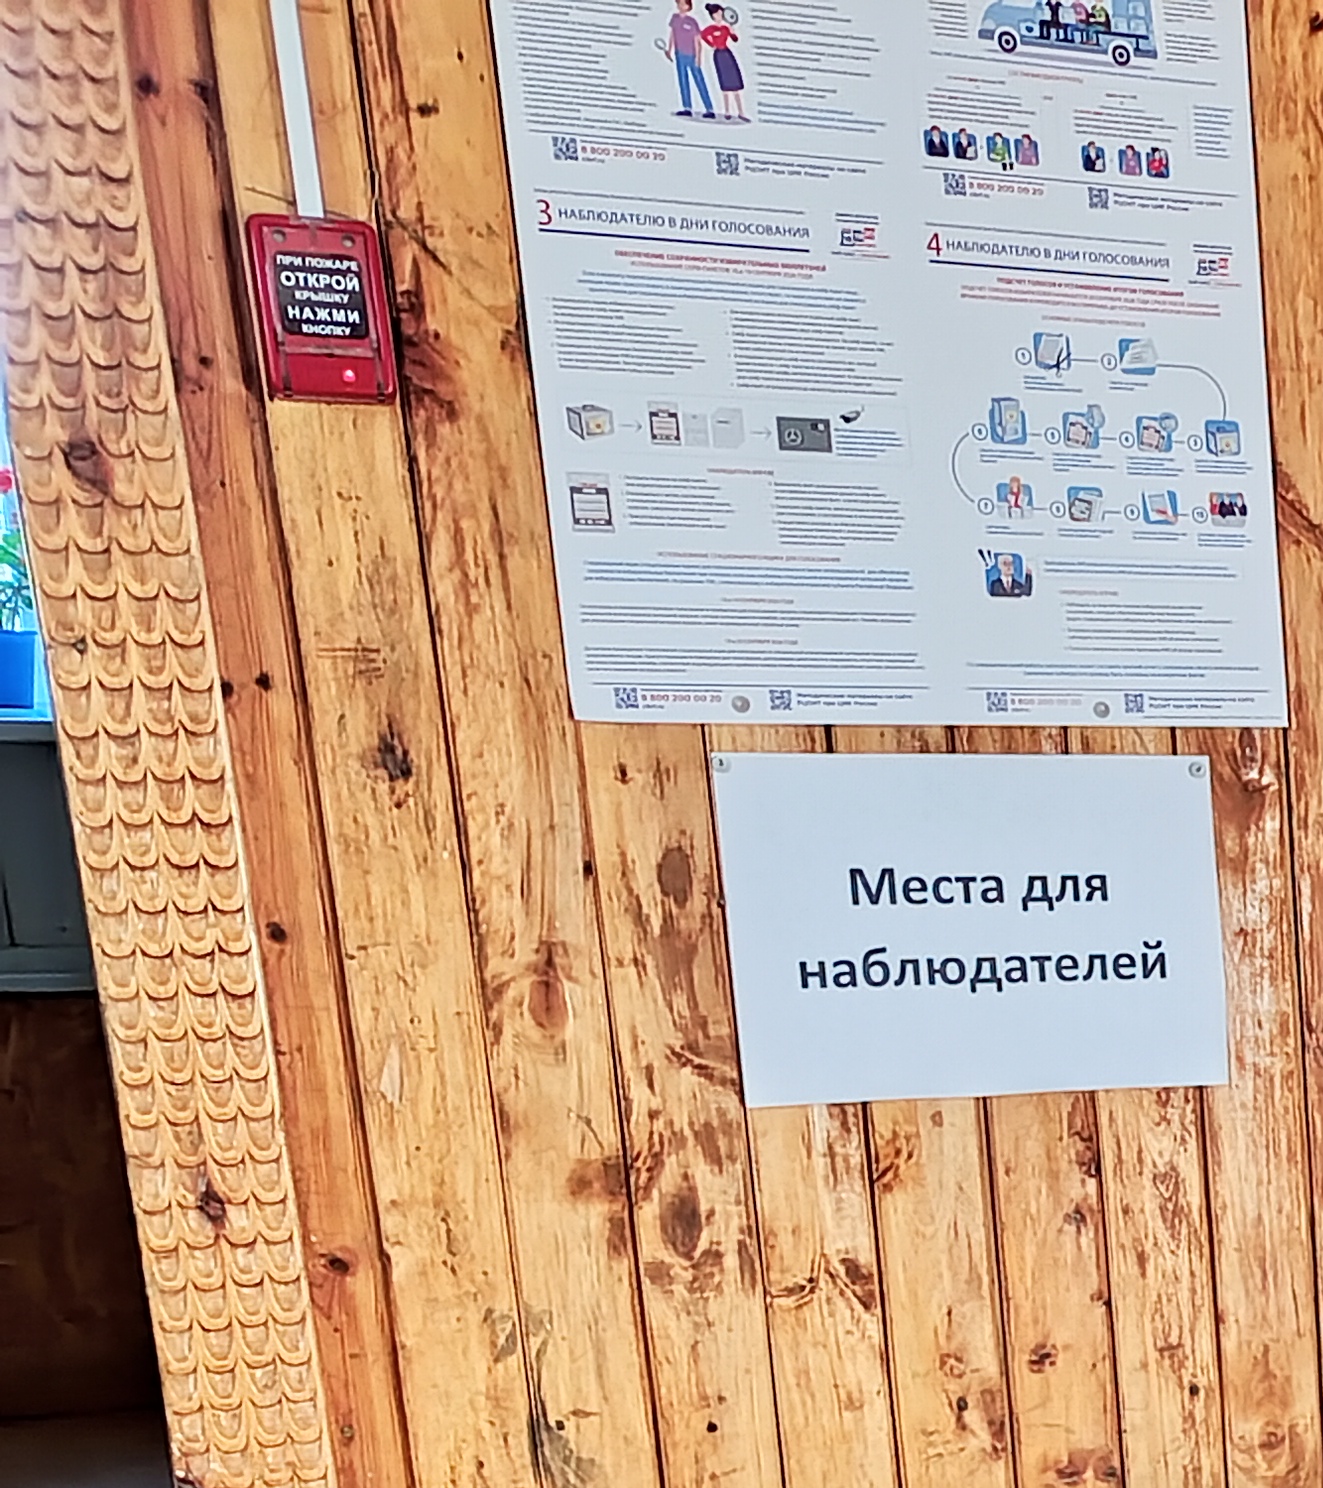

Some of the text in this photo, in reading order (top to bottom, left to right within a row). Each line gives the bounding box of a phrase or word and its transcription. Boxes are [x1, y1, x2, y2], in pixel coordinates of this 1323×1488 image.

[536, 199, 552, 226] 3
[558, 207, 665, 229] НАБЛЮДАТЕЛЮ
[668, 217, 678, 229] В
[680, 218, 709, 232] ДНИ
[712, 220, 810, 239] ГОЛОСОВАНИЯ
[926, 233, 943, 256] 4
[946, 240, 1041, 259] НАБЛЮДАТЕЛЮ
[1044, 249, 1051, 259] В
[1054, 249, 1081, 262] ДНИ
[1083, 251, 1170, 269] ГОЛОСОВАНИЯ
[276, 254, 359, 272] ПРИ ПОЖАРЕ
[280, 271, 360, 292] ОТКРОЙ
[294, 290, 350, 304] КРЫШКУ
[287, 305, 361, 324] НАЖМИ
[301, 323, 352, 336] КНОПКУ
[848, 867, 1109, 911] Места для
[798, 940, 1168, 993] наблюдателей
